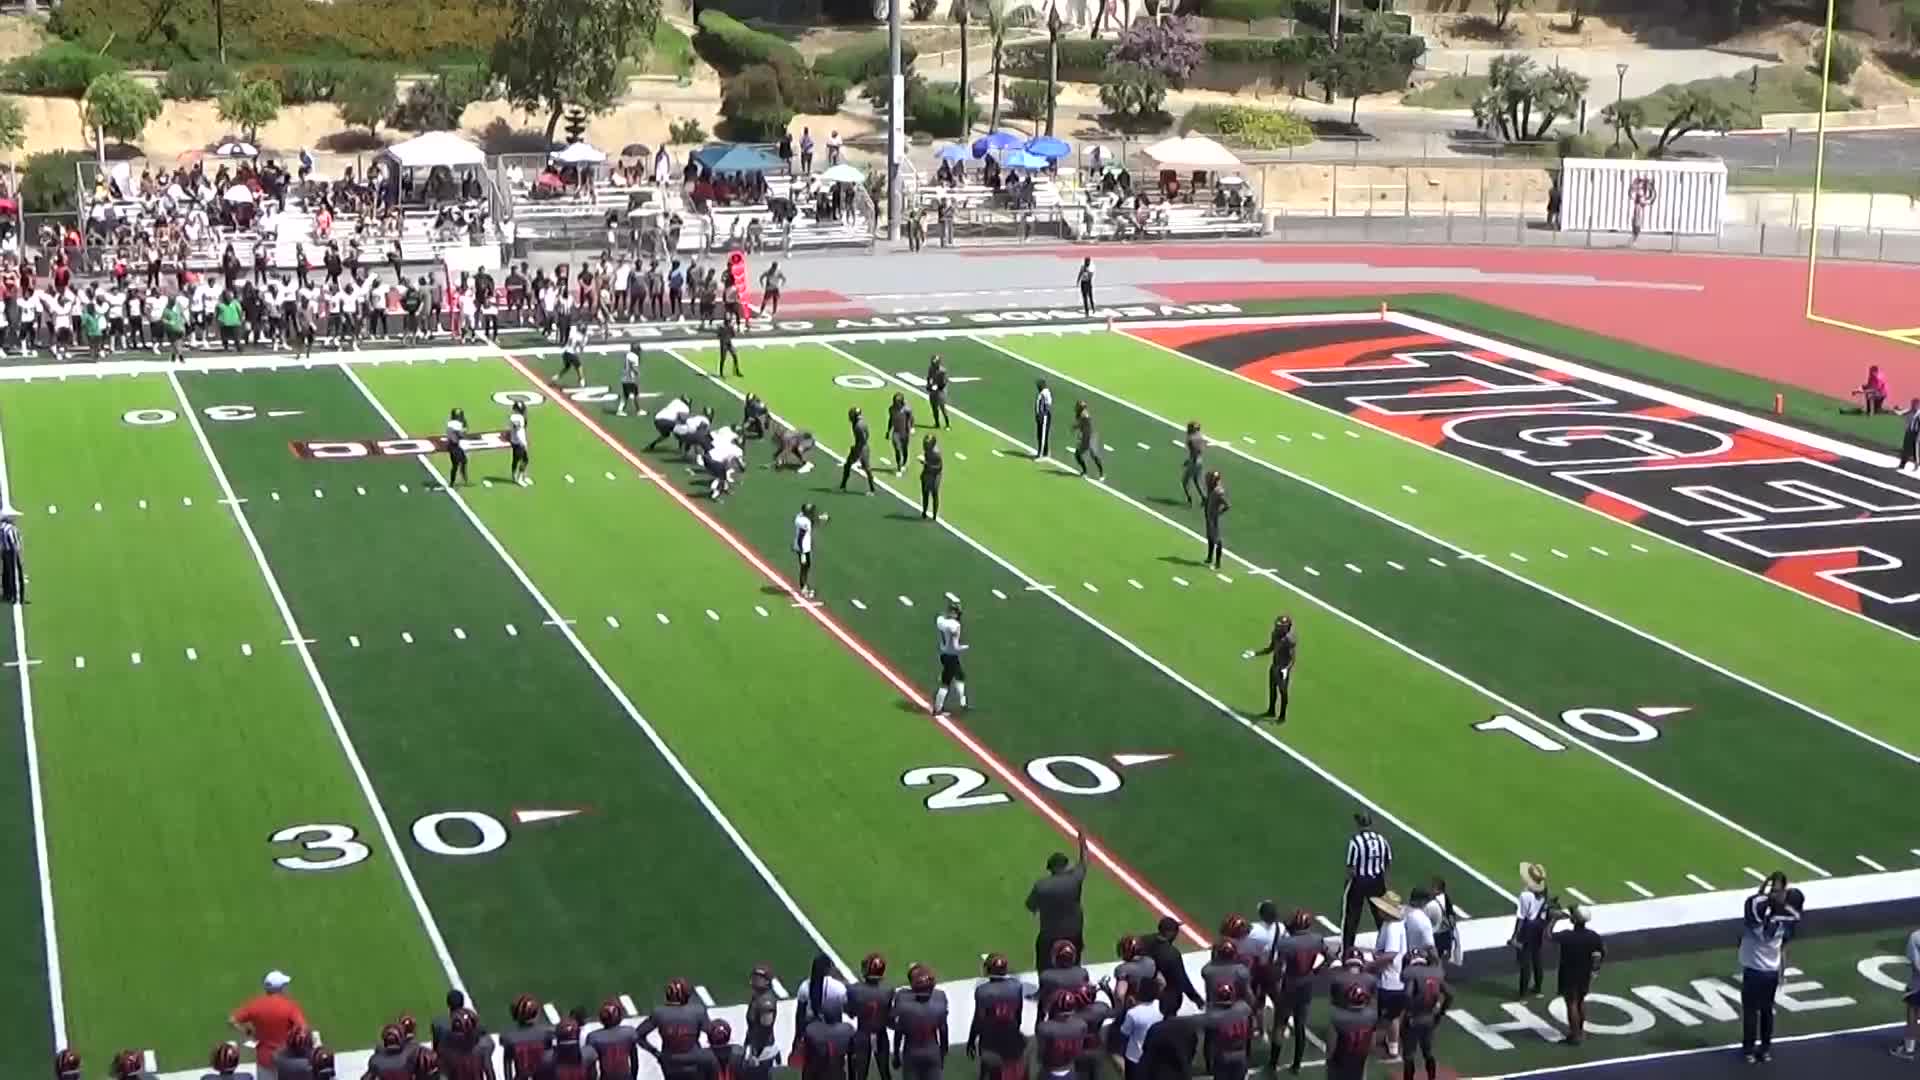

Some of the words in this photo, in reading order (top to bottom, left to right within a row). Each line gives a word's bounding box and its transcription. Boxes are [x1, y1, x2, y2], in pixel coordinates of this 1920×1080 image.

[1472, 708, 1660, 751] 10
[901, 753, 1124, 811] 20
[268, 822, 510, 873] 30
[1446, 968, 1858, 1051] HOME
